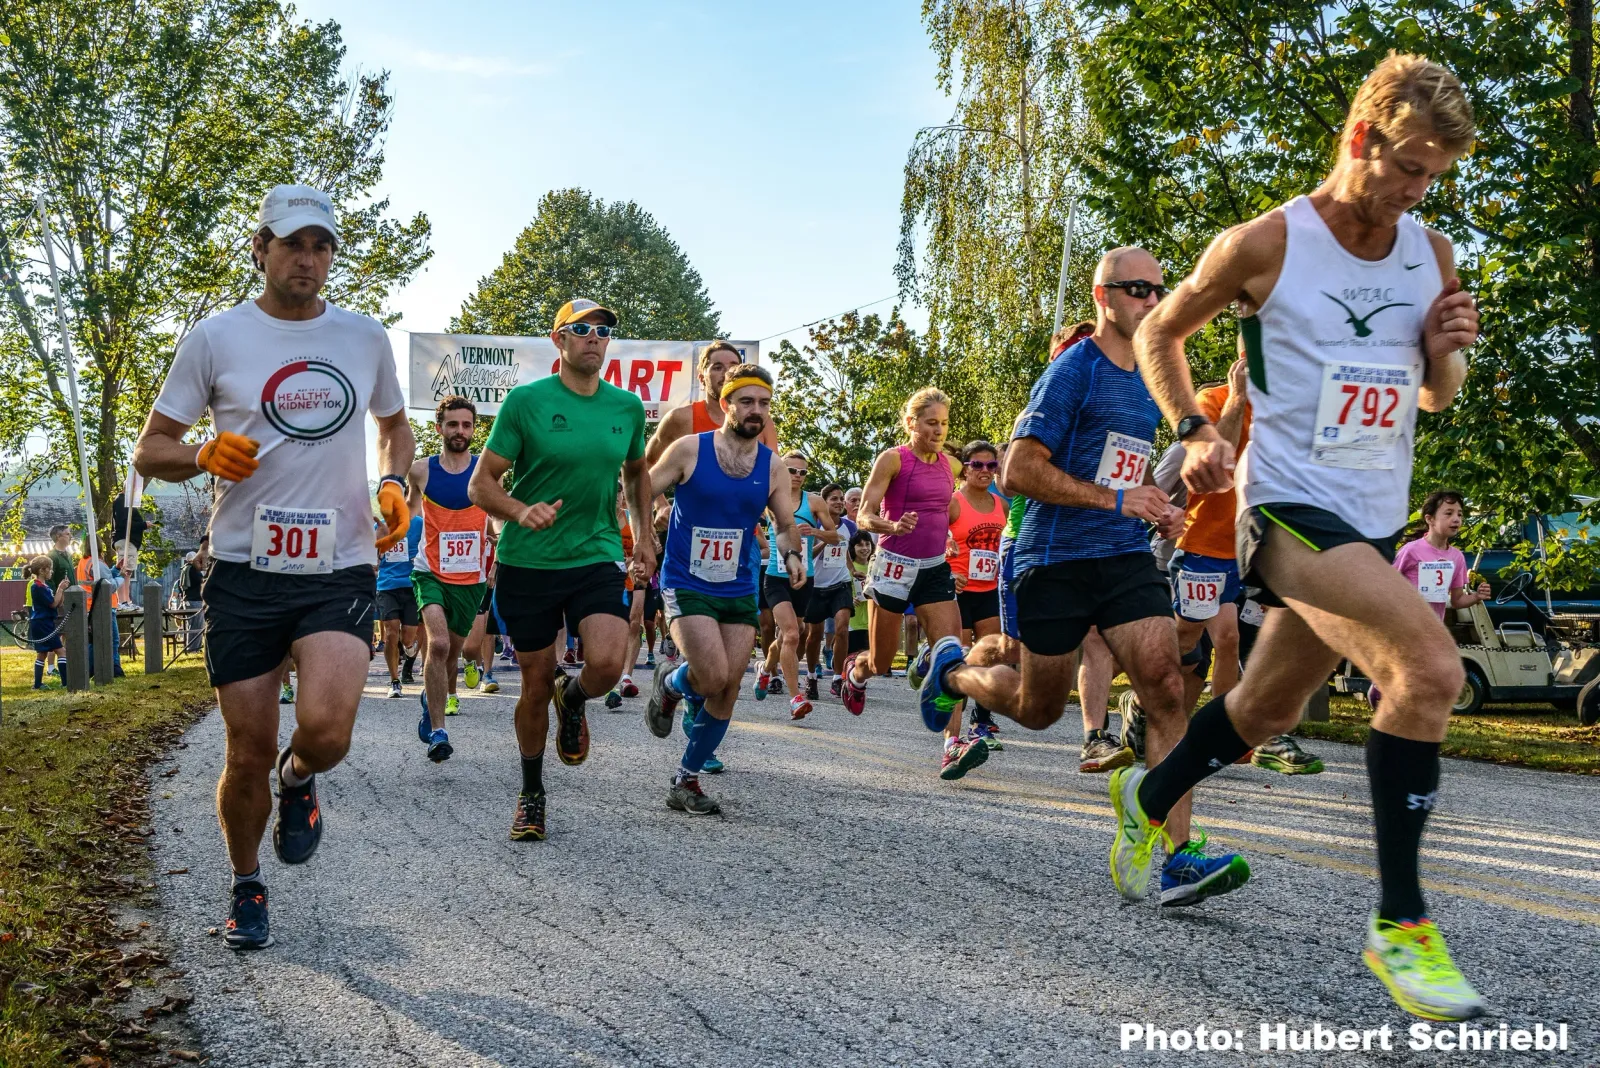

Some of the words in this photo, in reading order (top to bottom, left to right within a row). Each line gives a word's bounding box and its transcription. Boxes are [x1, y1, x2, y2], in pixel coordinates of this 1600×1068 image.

[1342, 287, 1395, 303] WTAC
[461, 346, 514, 366] VERMONT
[431, 352, 519, 391] Natural
[551, 359, 683, 402] ART
[277, 391, 331, 401] HEALTHY
[278, 401, 320, 410] KIDNEY
[323, 400, 342, 409] 10K
[1337, 384, 1399, 428] 792
[266, 524, 319, 559] 301
[447, 540, 473, 557] 587
[700, 538, 733, 561] 716
[831, 547, 841, 557] 91
[883, 562, 904, 580] 18
[1435, 569, 1444, 586] 3
[1186, 582, 1218, 601] 103
